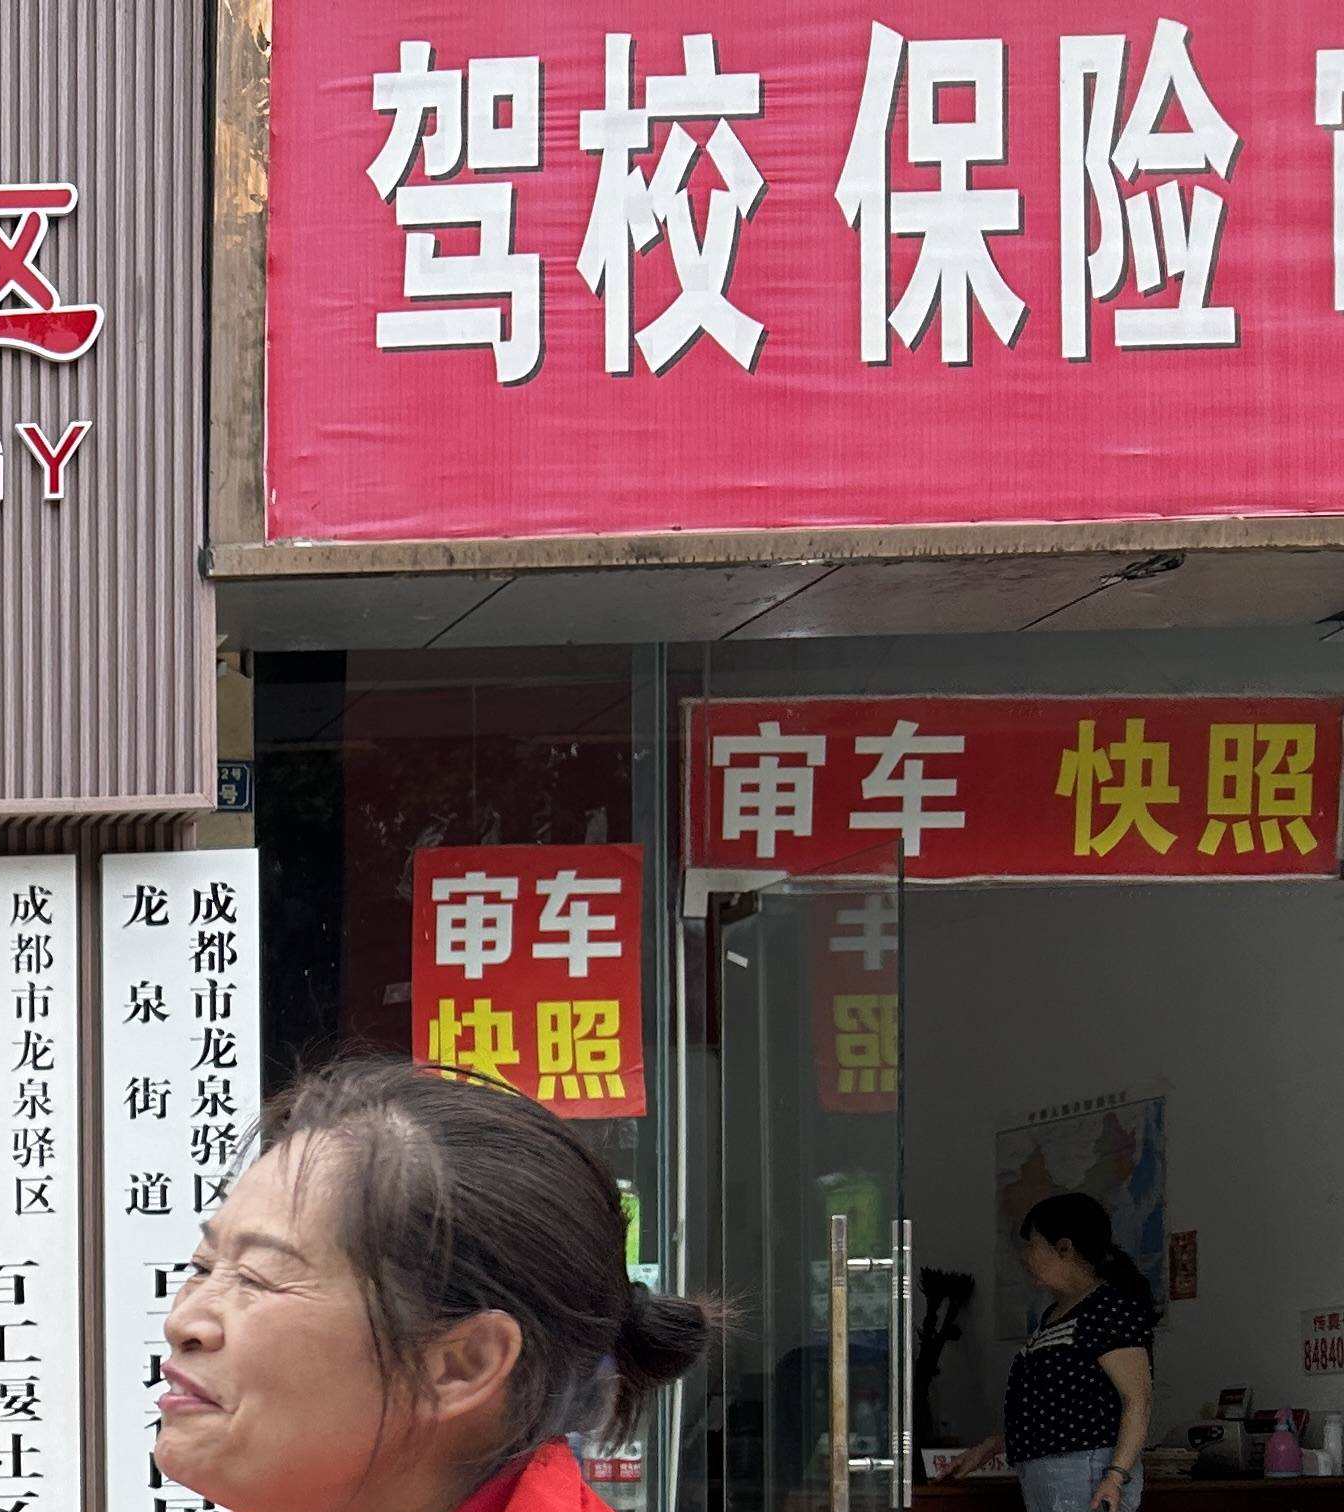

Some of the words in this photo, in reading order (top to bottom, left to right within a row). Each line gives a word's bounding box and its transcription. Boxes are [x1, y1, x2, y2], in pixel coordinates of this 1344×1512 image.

[366, 19, 1344, 384] 驾校保险
[712, 720, 965, 858] 审车
[1055, 718, 1318, 857] 快照
[431, 869, 622, 979] 审车
[10, 884, 56, 1216] 成都市龙泉驿区
[122, 884, 173, 1216] 龙泉街道
[188, 881, 240, 1213] 成都市龙泉驿区
[427, 997, 626, 1100] 快照
[1313, 1312, 1344, 1332] 传真
